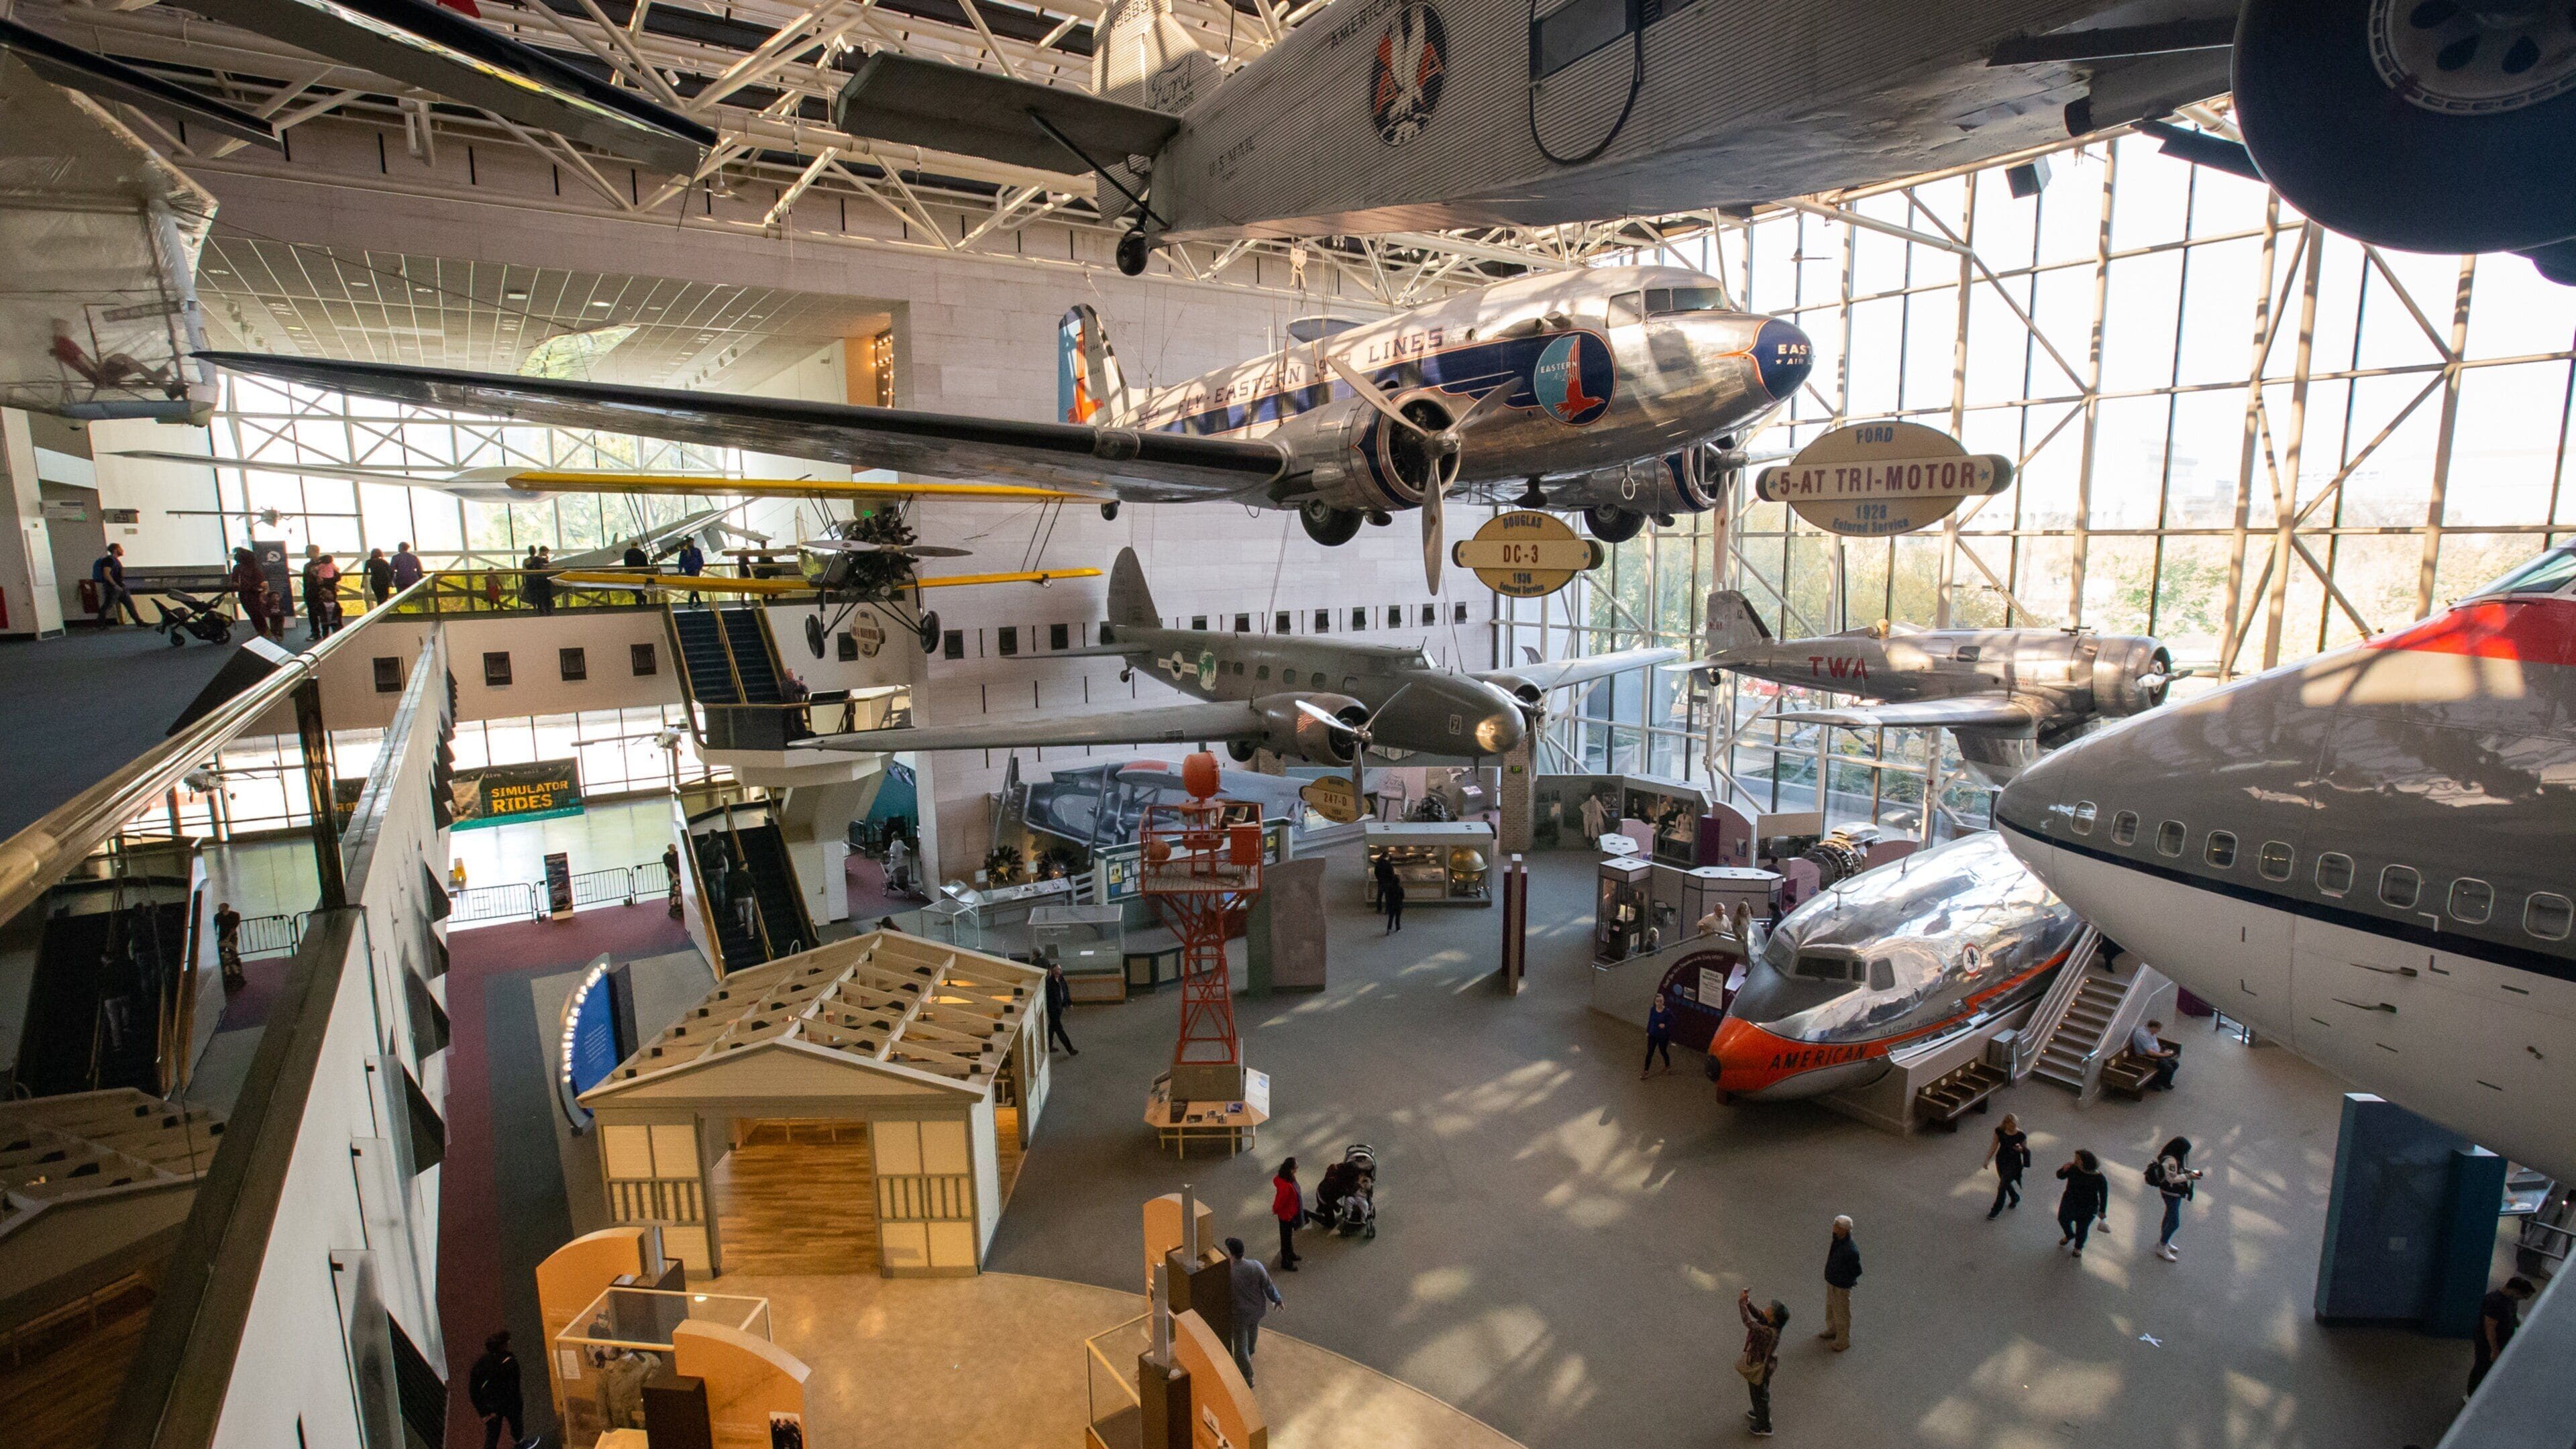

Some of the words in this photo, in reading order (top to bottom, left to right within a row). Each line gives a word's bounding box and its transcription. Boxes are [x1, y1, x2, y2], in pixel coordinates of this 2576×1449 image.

[1331, 0, 1396, 48] AMERICA
[1150, 55, 1193, 109] Ford
[1368, 327, 1443, 363] LINES
[1315, 352, 1352, 378] AR
[1540, 361, 1578, 374] EASTERN
[1856, 427, 1894, 443] FORD
[1780, 470, 1826, 495] 5-AT
[1835, 462, 1976, 493] TRI-MOTOR
[1503, 514, 1542, 529] DOUGLAS
[1856, 504, 1886, 520] 1928
[1503, 545, 1538, 563] DC-3
[1809, 657, 1868, 680] TWA
[491, 780, 568, 798] SIMULATOR
[492, 794, 553, 814] RIDES
[1768, 1045, 1868, 1071] AMERICAN
